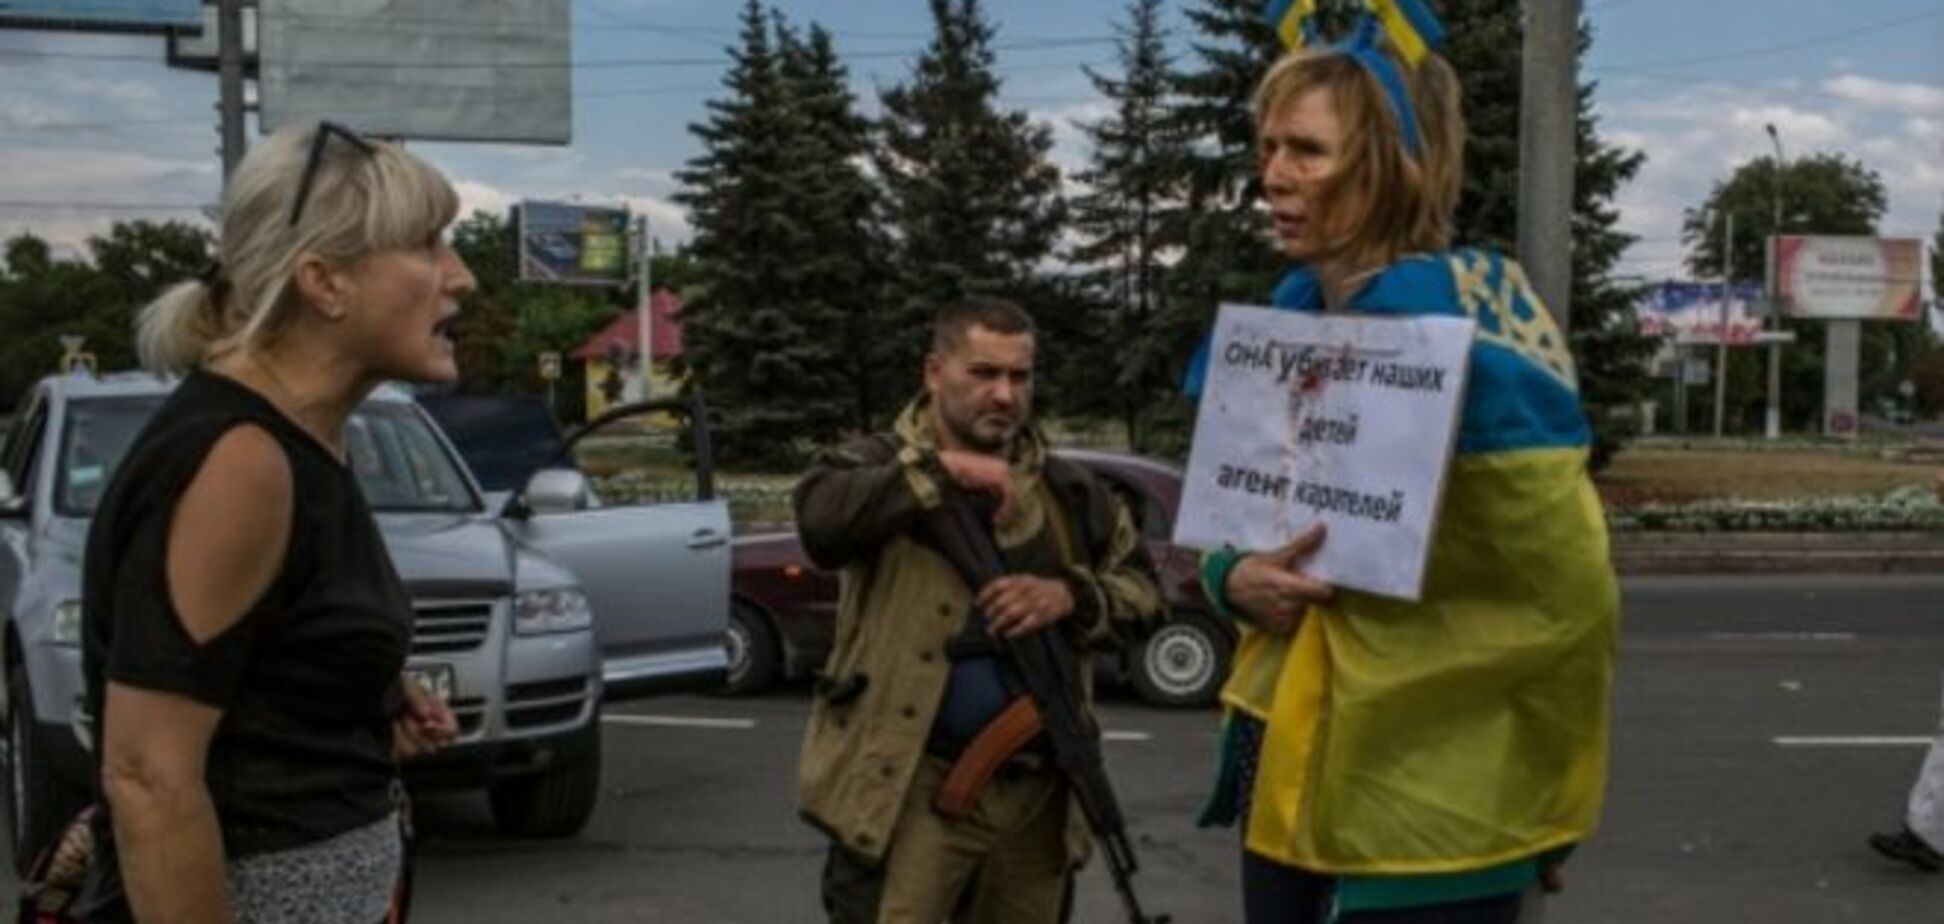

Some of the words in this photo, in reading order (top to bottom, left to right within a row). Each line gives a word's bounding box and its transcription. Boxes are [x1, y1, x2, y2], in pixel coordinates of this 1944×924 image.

[1369, 362, 1447, 391] наших
[1297, 414, 1360, 447] детей
[1217, 463, 1290, 499] агент
[1293, 480, 1406, 522] карателей
